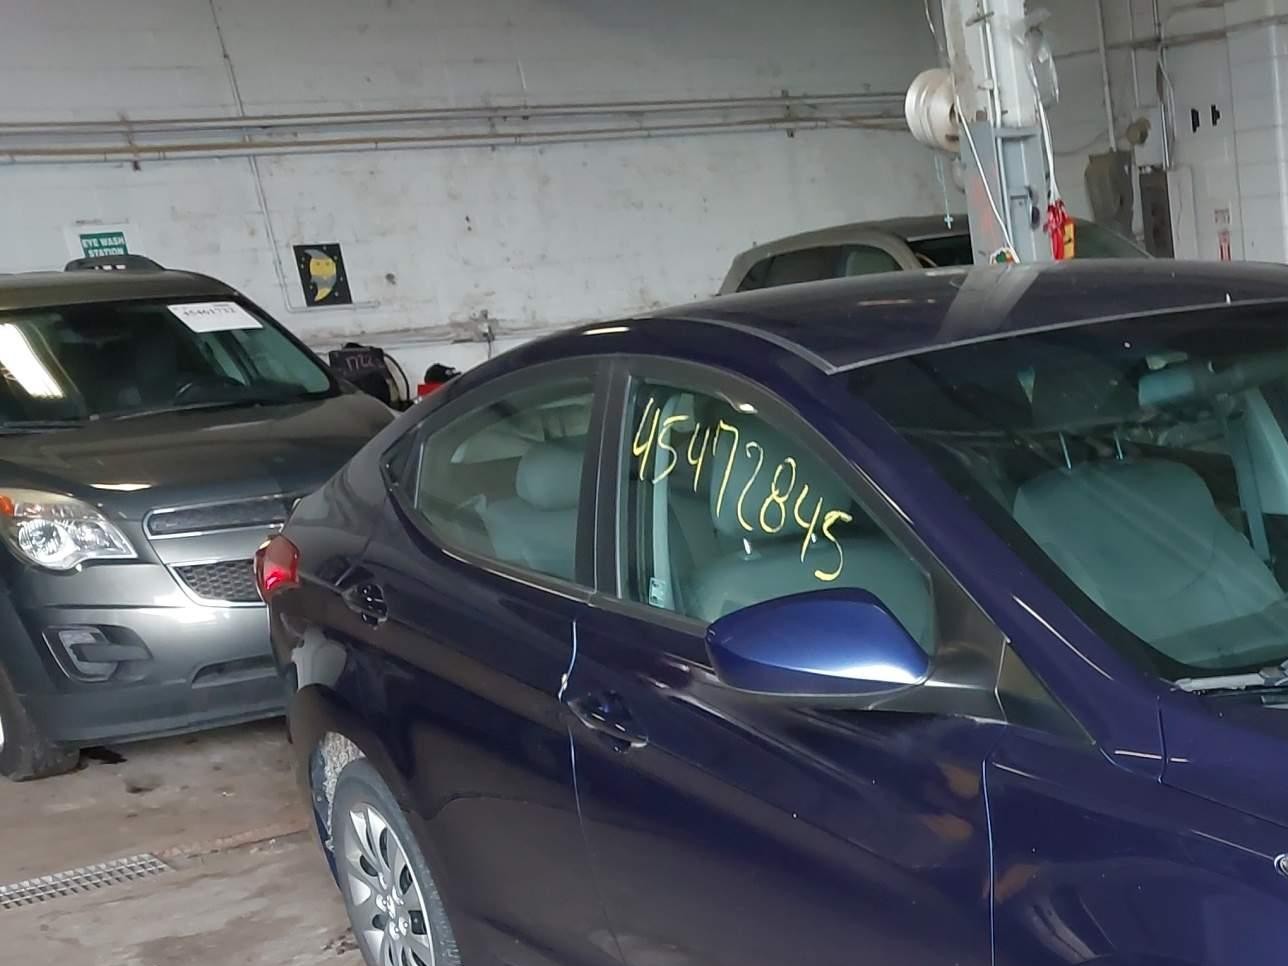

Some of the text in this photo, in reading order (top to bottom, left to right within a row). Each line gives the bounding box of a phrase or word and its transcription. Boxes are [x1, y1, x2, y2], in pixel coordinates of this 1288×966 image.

[81, 235, 125, 248] EYE WASH
[87, 246, 125, 258] STATION
[631, 397, 853, 582] 45472845
